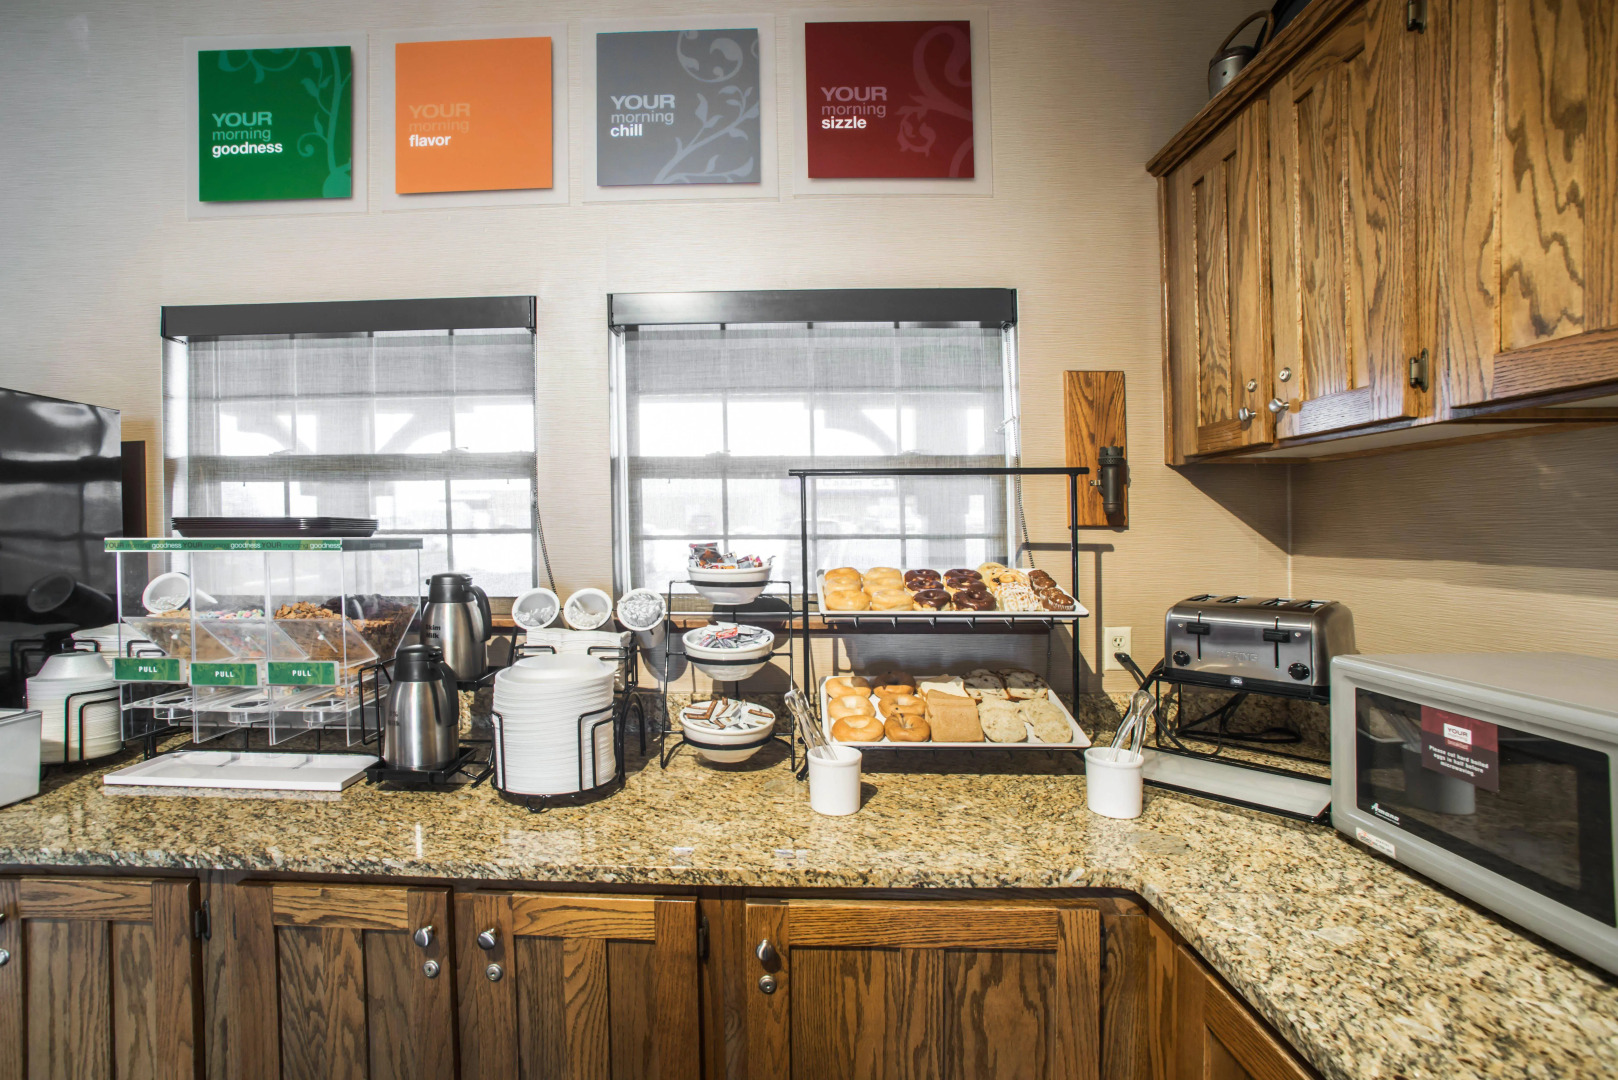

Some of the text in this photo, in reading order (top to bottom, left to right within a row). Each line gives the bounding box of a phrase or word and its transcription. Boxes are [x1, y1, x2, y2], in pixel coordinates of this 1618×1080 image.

[821, 86, 888, 102] YOUR
[610, 94, 676, 110] YOUR
[408, 103, 471, 119] YOUR
[821, 102, 887, 118] morning
[211, 111, 273, 128] YOUR
[611, 110, 675, 126] morning
[821, 115, 867, 129] sizzle
[409, 119, 470, 134] morning
[610, 124, 643, 137] chill
[212, 127, 272, 142] morning
[409, 134, 452, 147] flavor
[212, 141, 283, 158] goodness
[151, 541, 182, 551] goodness
[230, 541, 261, 551] goodness
[283, 542, 309, 551] morning
[309, 541, 341, 550] goodness
[138, 665, 158, 673] PULL
[214, 670, 235, 678] PULL
[292, 669, 312, 677] PULL
[1447, 727, 1468, 737] YOUR
[1429, 744, 1447, 755] Please
[1456, 753, 1470, 763] hard
[1433, 753, 1446, 762] eggs
[1465, 762, 1484, 773] before
[1371, 802, 1400, 822] Amana
